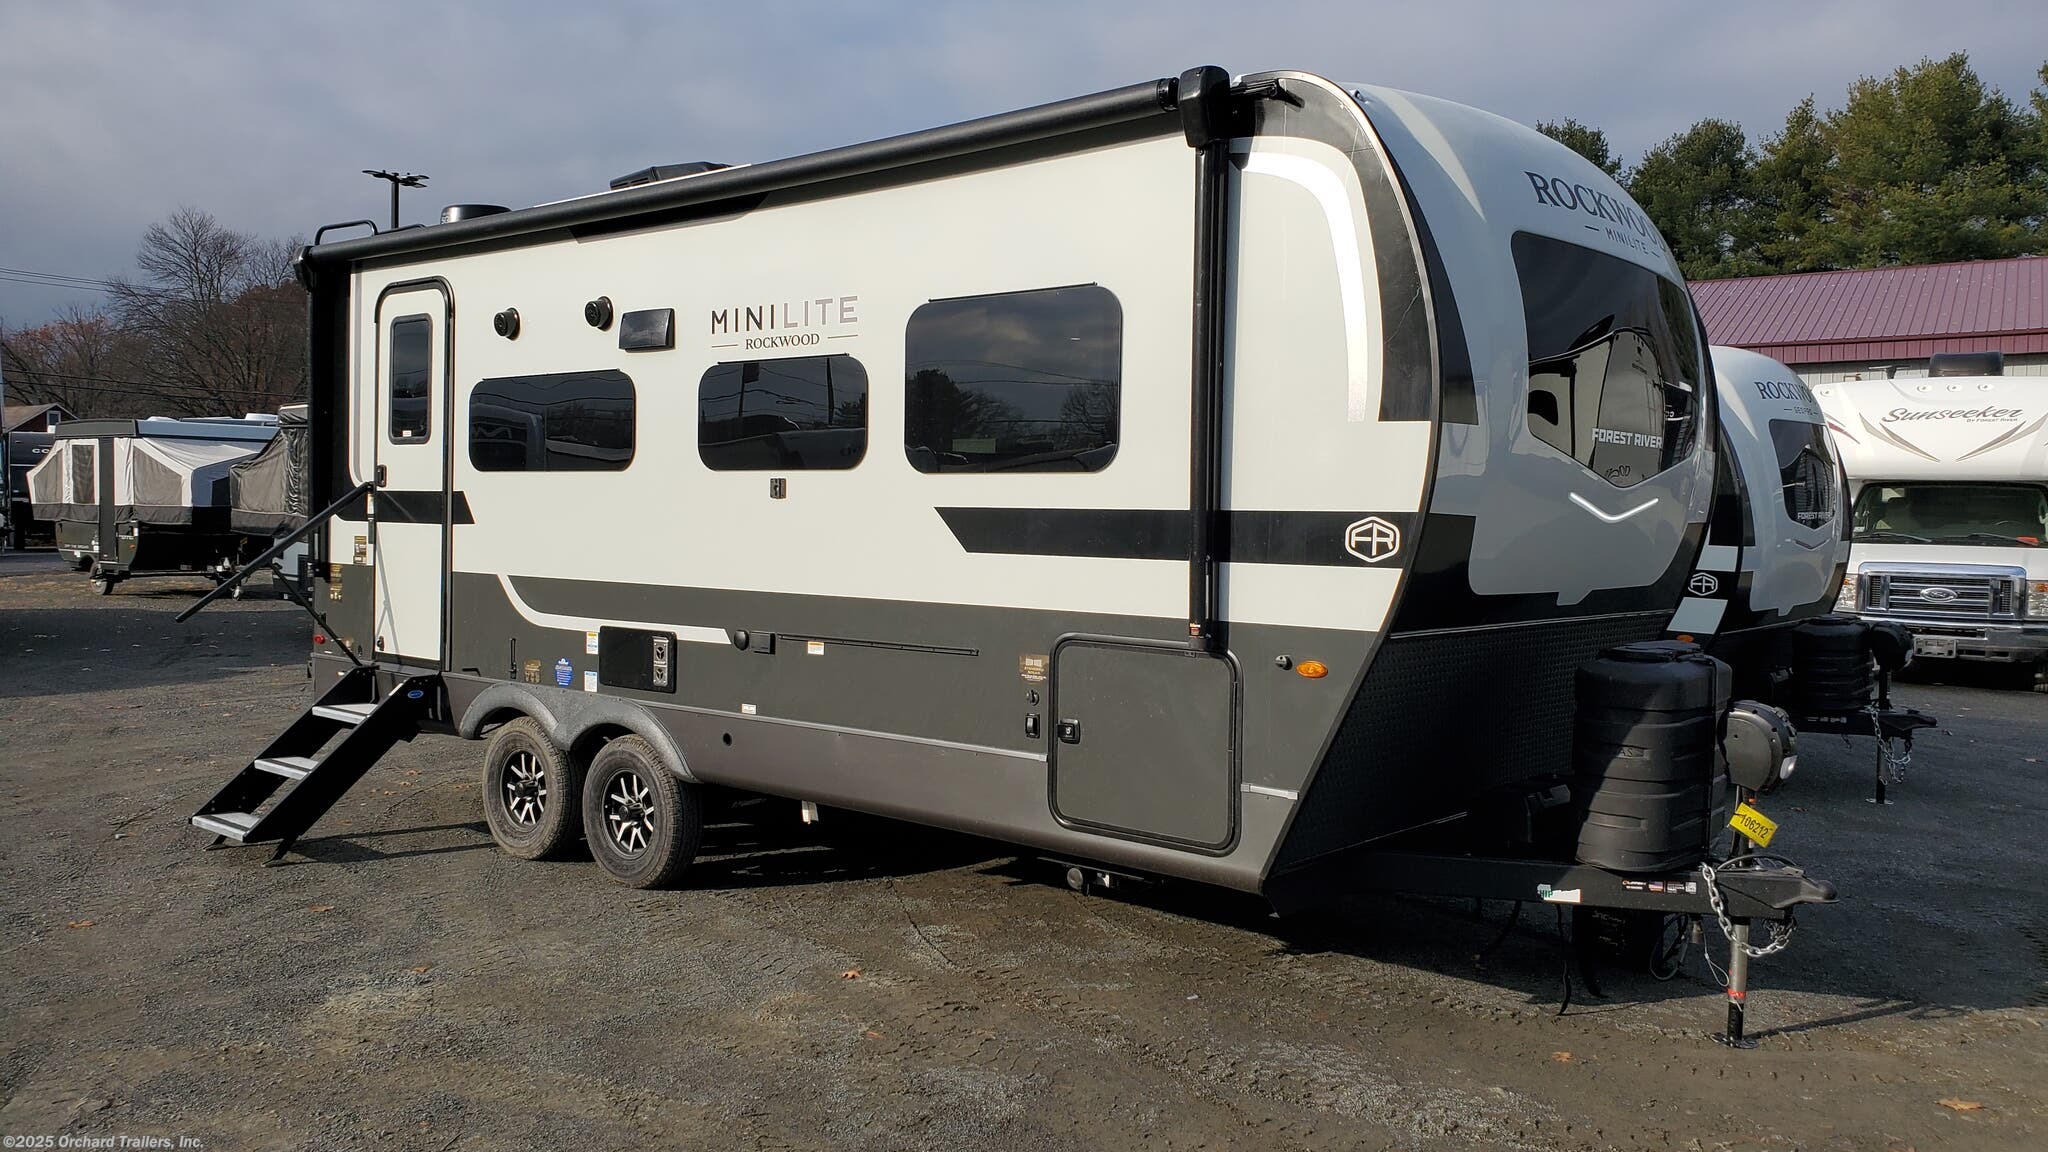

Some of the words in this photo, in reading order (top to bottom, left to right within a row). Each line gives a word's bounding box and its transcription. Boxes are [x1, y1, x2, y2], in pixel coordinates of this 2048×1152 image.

[1605, 227, 1649, 255] MINILITE
[711, 295, 858, 335] MINILITE
[745, 333, 820, 350] ROCKWOOD
[1881, 405, 2024, 423] Sunseeker
[1592, 428, 1633, 446] FOREST
[1634, 433, 1662, 448] RIVER
